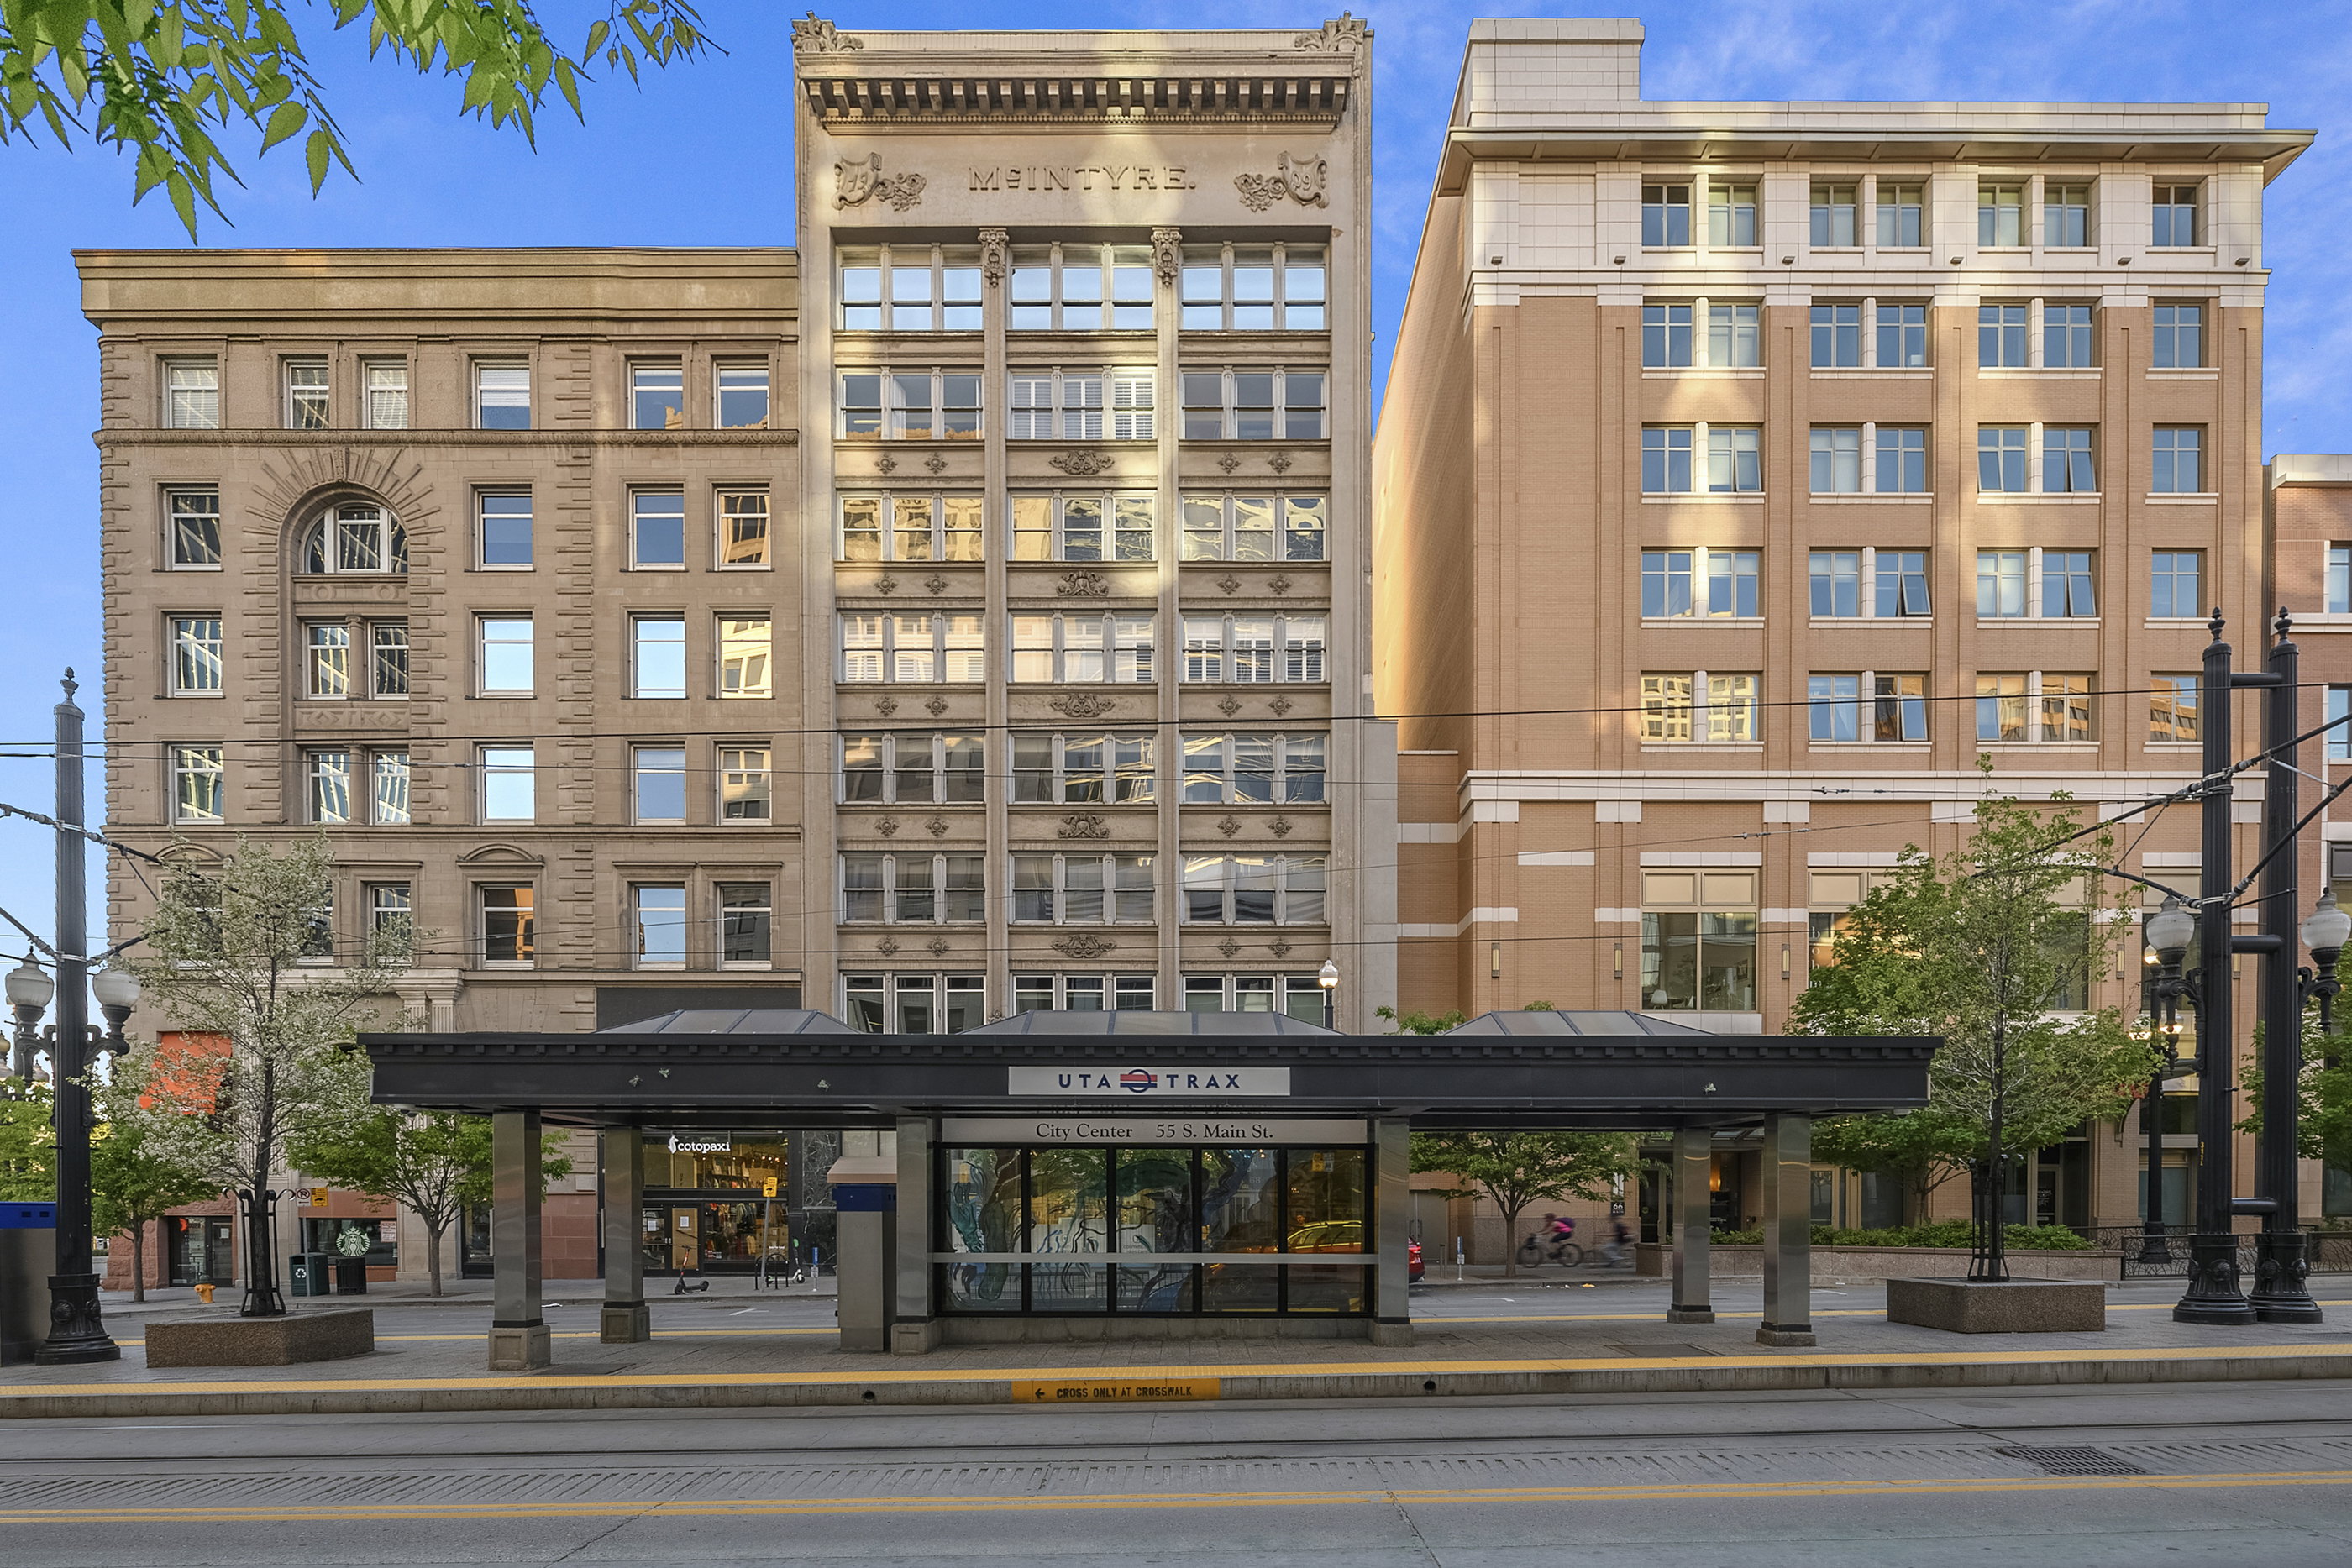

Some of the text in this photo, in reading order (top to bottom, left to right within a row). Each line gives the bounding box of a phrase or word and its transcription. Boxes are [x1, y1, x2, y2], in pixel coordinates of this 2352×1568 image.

[1058, 1073, 1240, 1088] UTA TRAX
[1036, 1123, 1274, 1141] City Center 55 S. Main St.
[677, 1141, 731, 1153] cotopaxi
[1057, 1387, 1193, 1398] CROSS ONLY AT CROSSWALK
